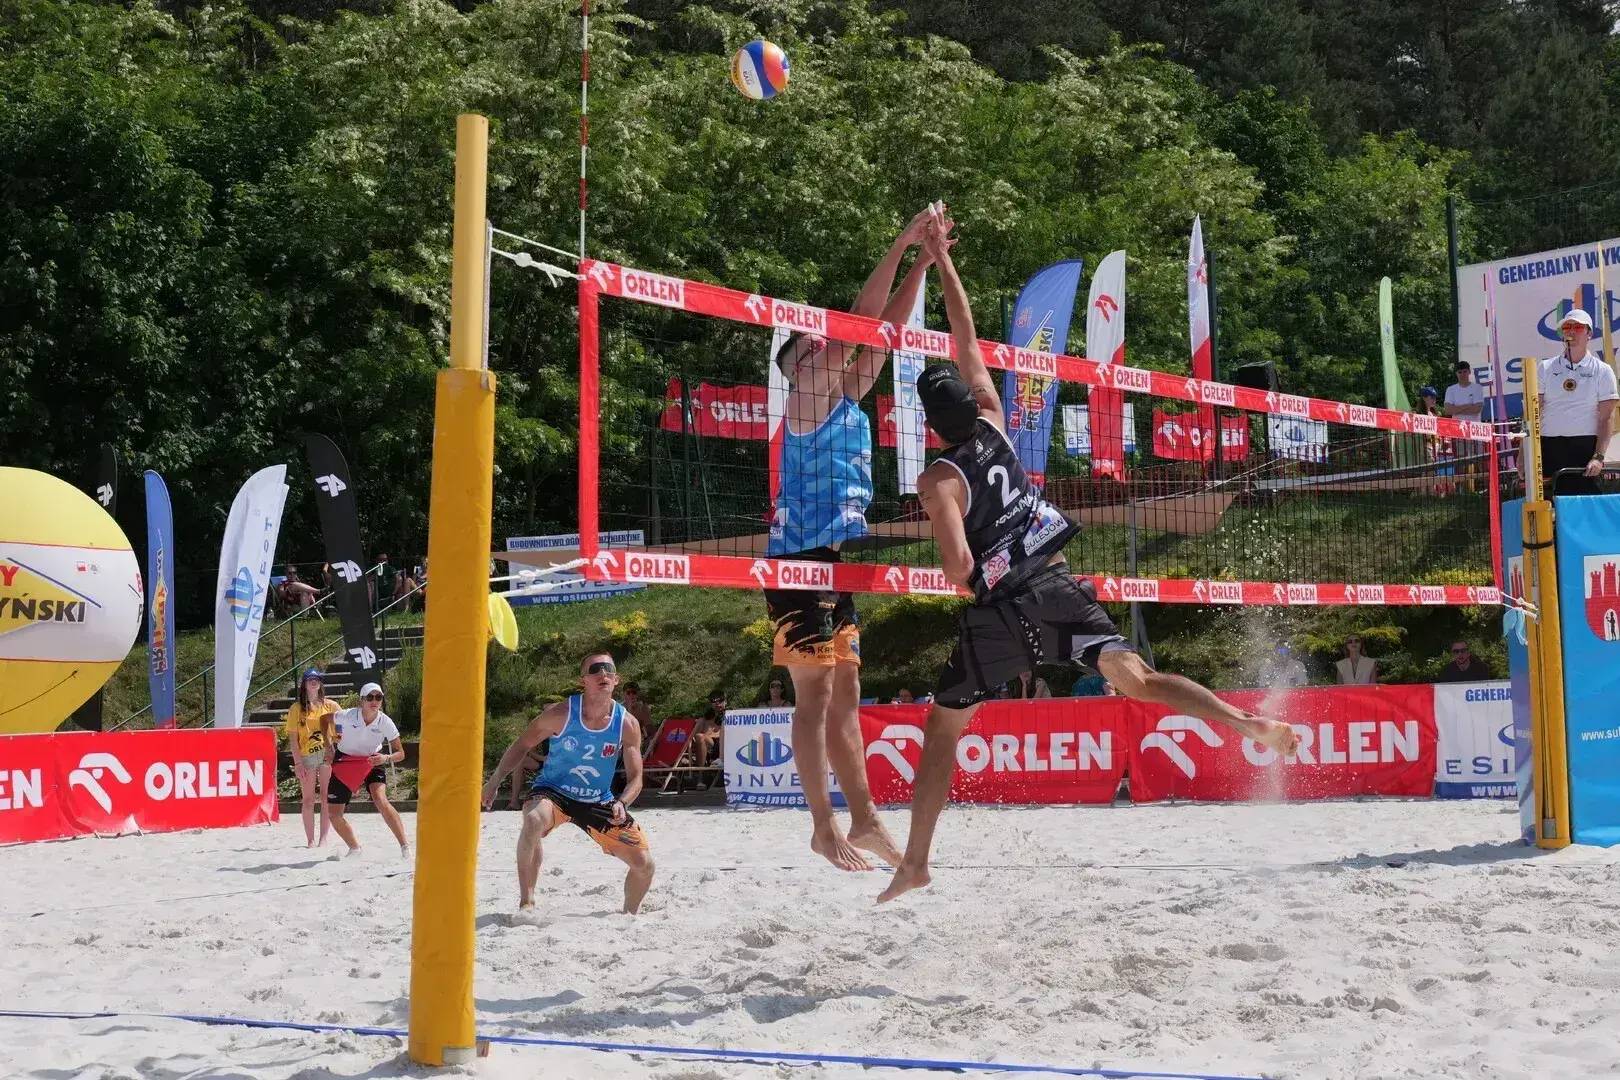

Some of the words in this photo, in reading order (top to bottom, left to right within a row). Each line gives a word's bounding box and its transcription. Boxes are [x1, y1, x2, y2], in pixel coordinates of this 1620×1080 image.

[1499, 254, 1581, 285] GENERALNY
[625, 273, 680, 303] ORLEN
[775, 303, 823, 331] ORLEN
[904, 330, 946, 353] ORLEN
[1017, 351, 1054, 373] ORLEN
[1116, 369, 1148, 389] ORLEN
[1203, 386, 1232, 402] ORLEN
[711, 402, 768, 423] ORLE
[1282, 398, 1307, 414] ORLEN
[1351, 409, 1375, 424] ORLEN
[1414, 417, 1435, 431] ORLEN
[1471, 424, 1491, 437] ORLEN
[987, 464, 1021, 509] 2
[630, 557, 685, 579] ORLEN
[781, 566, 829, 585] ORLEN
[1123, 582, 1156, 597] ORLEN
[1211, 585, 1240, 600] ORLEN
[1289, 586, 1315, 601] ORLEN
[1359, 588, 1383, 601] ORLEN
[1421, 588, 1443, 601] ORLEN
[1478, 589, 1498, 601] ORLEN
[759, 711, 790, 724] OGÓLNE
[582, 744, 595, 760] 2
[955, 731, 1112, 773] ORLEN
[1242, 720, 1420, 767] ORLEN
[144, 759, 264, 801] ORLEN
